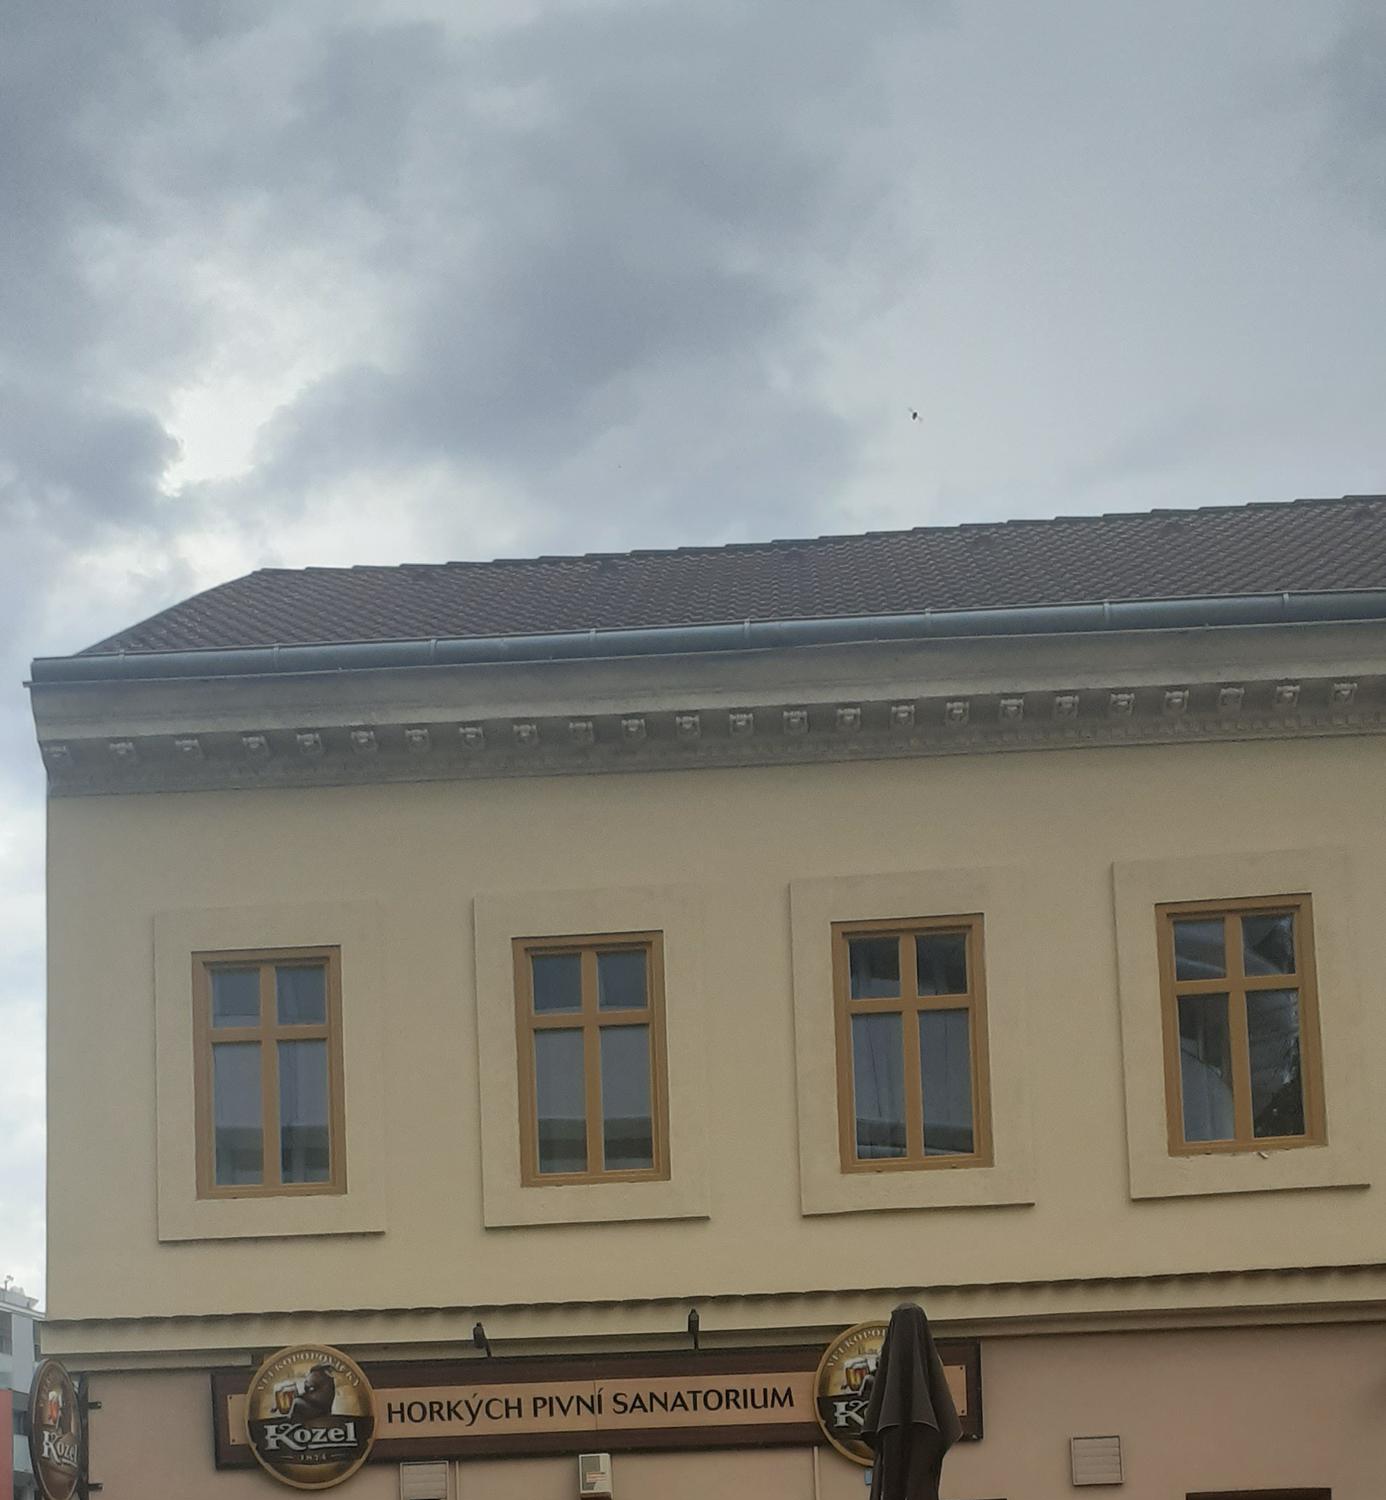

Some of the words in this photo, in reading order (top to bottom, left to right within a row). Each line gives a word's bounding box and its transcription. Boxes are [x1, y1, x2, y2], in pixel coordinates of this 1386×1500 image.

[387, 1393, 523, 1427] HORKÝCH
[532, 1387, 604, 1417] PIVNÍ
[612, 1387, 795, 1415] SANATORIUM
[42, 1430, 78, 1467] Kozel
[264, 1422, 358, 1451] Kozel
